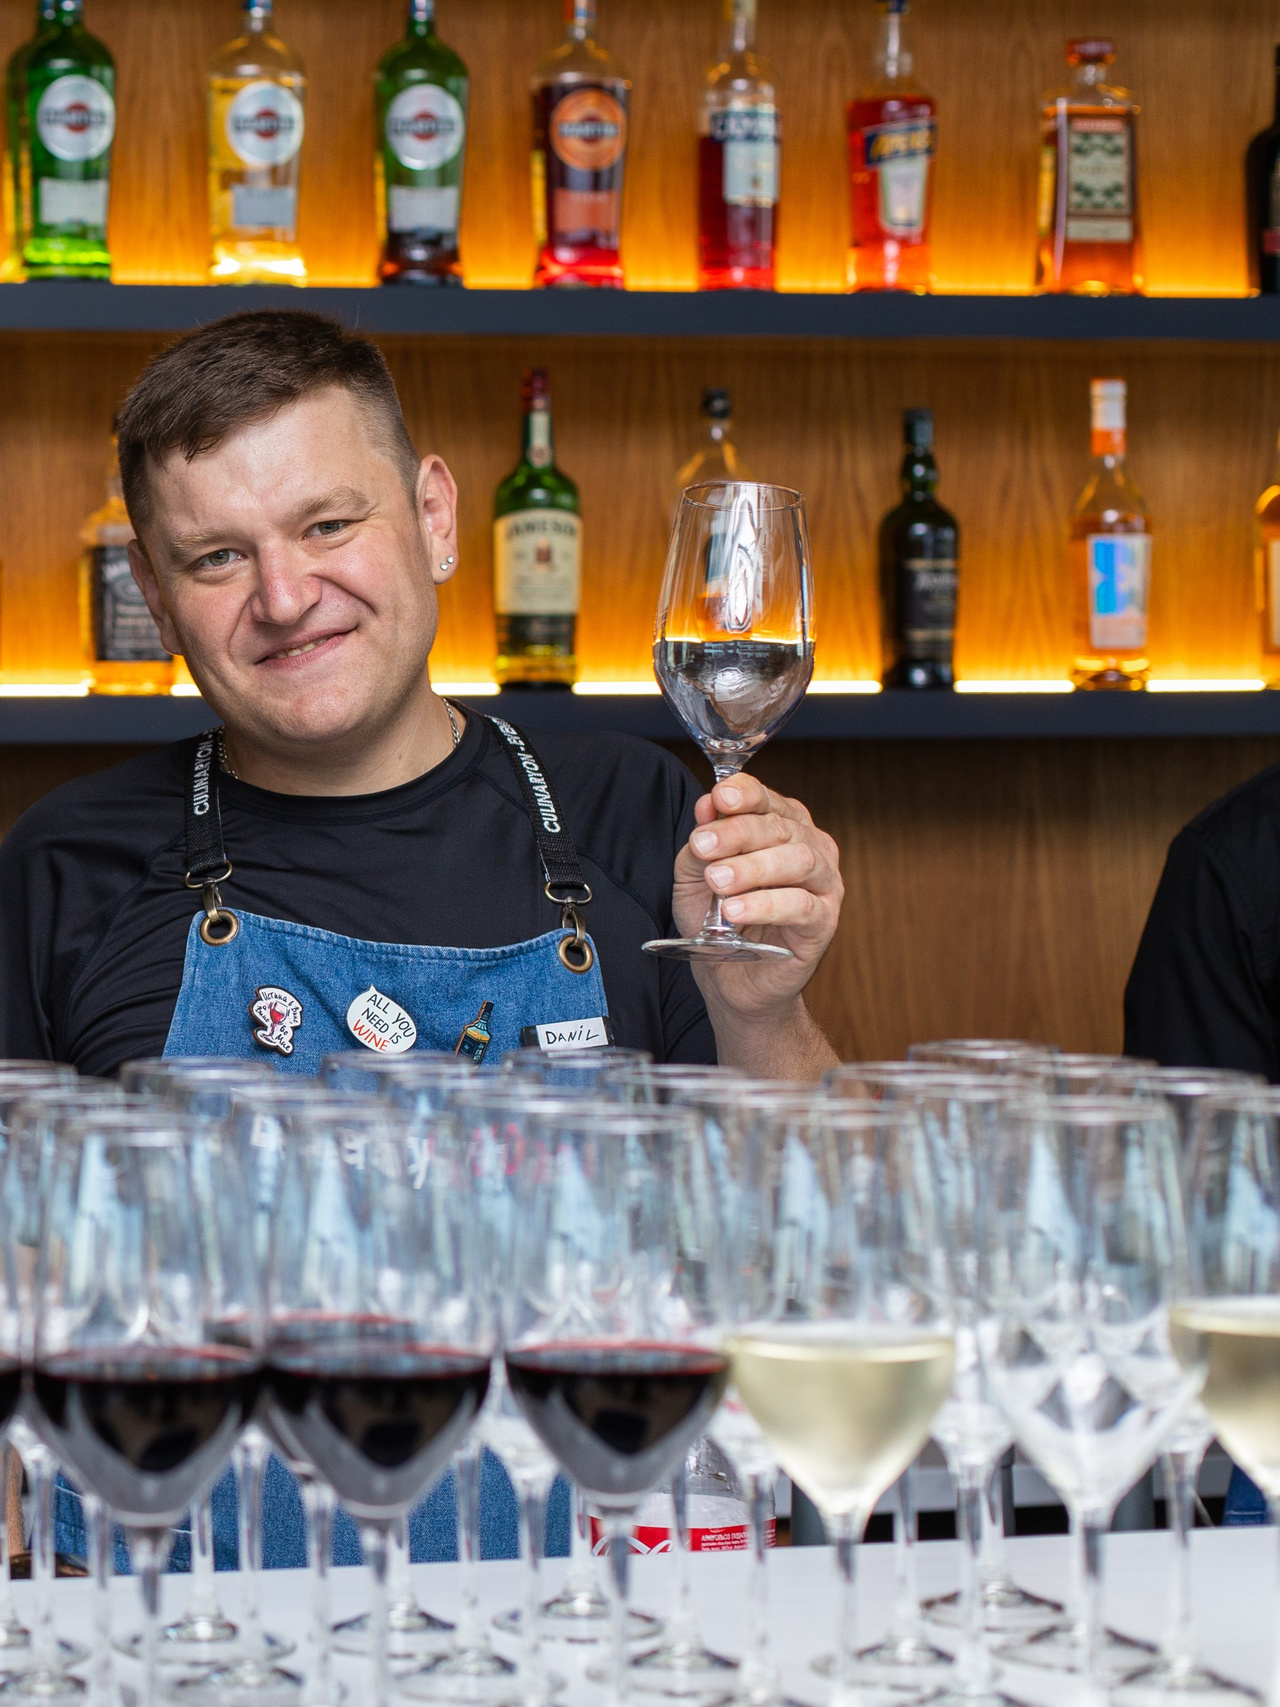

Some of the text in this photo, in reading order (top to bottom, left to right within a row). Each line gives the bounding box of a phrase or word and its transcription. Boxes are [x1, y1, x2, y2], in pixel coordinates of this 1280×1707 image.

[517, 752, 561, 833] CULINARYON
[352, 1018, 391, 1052] WINE
[361, 1007, 402, 1045] NEED IS
[366, 993, 415, 1038] ALL YOU
